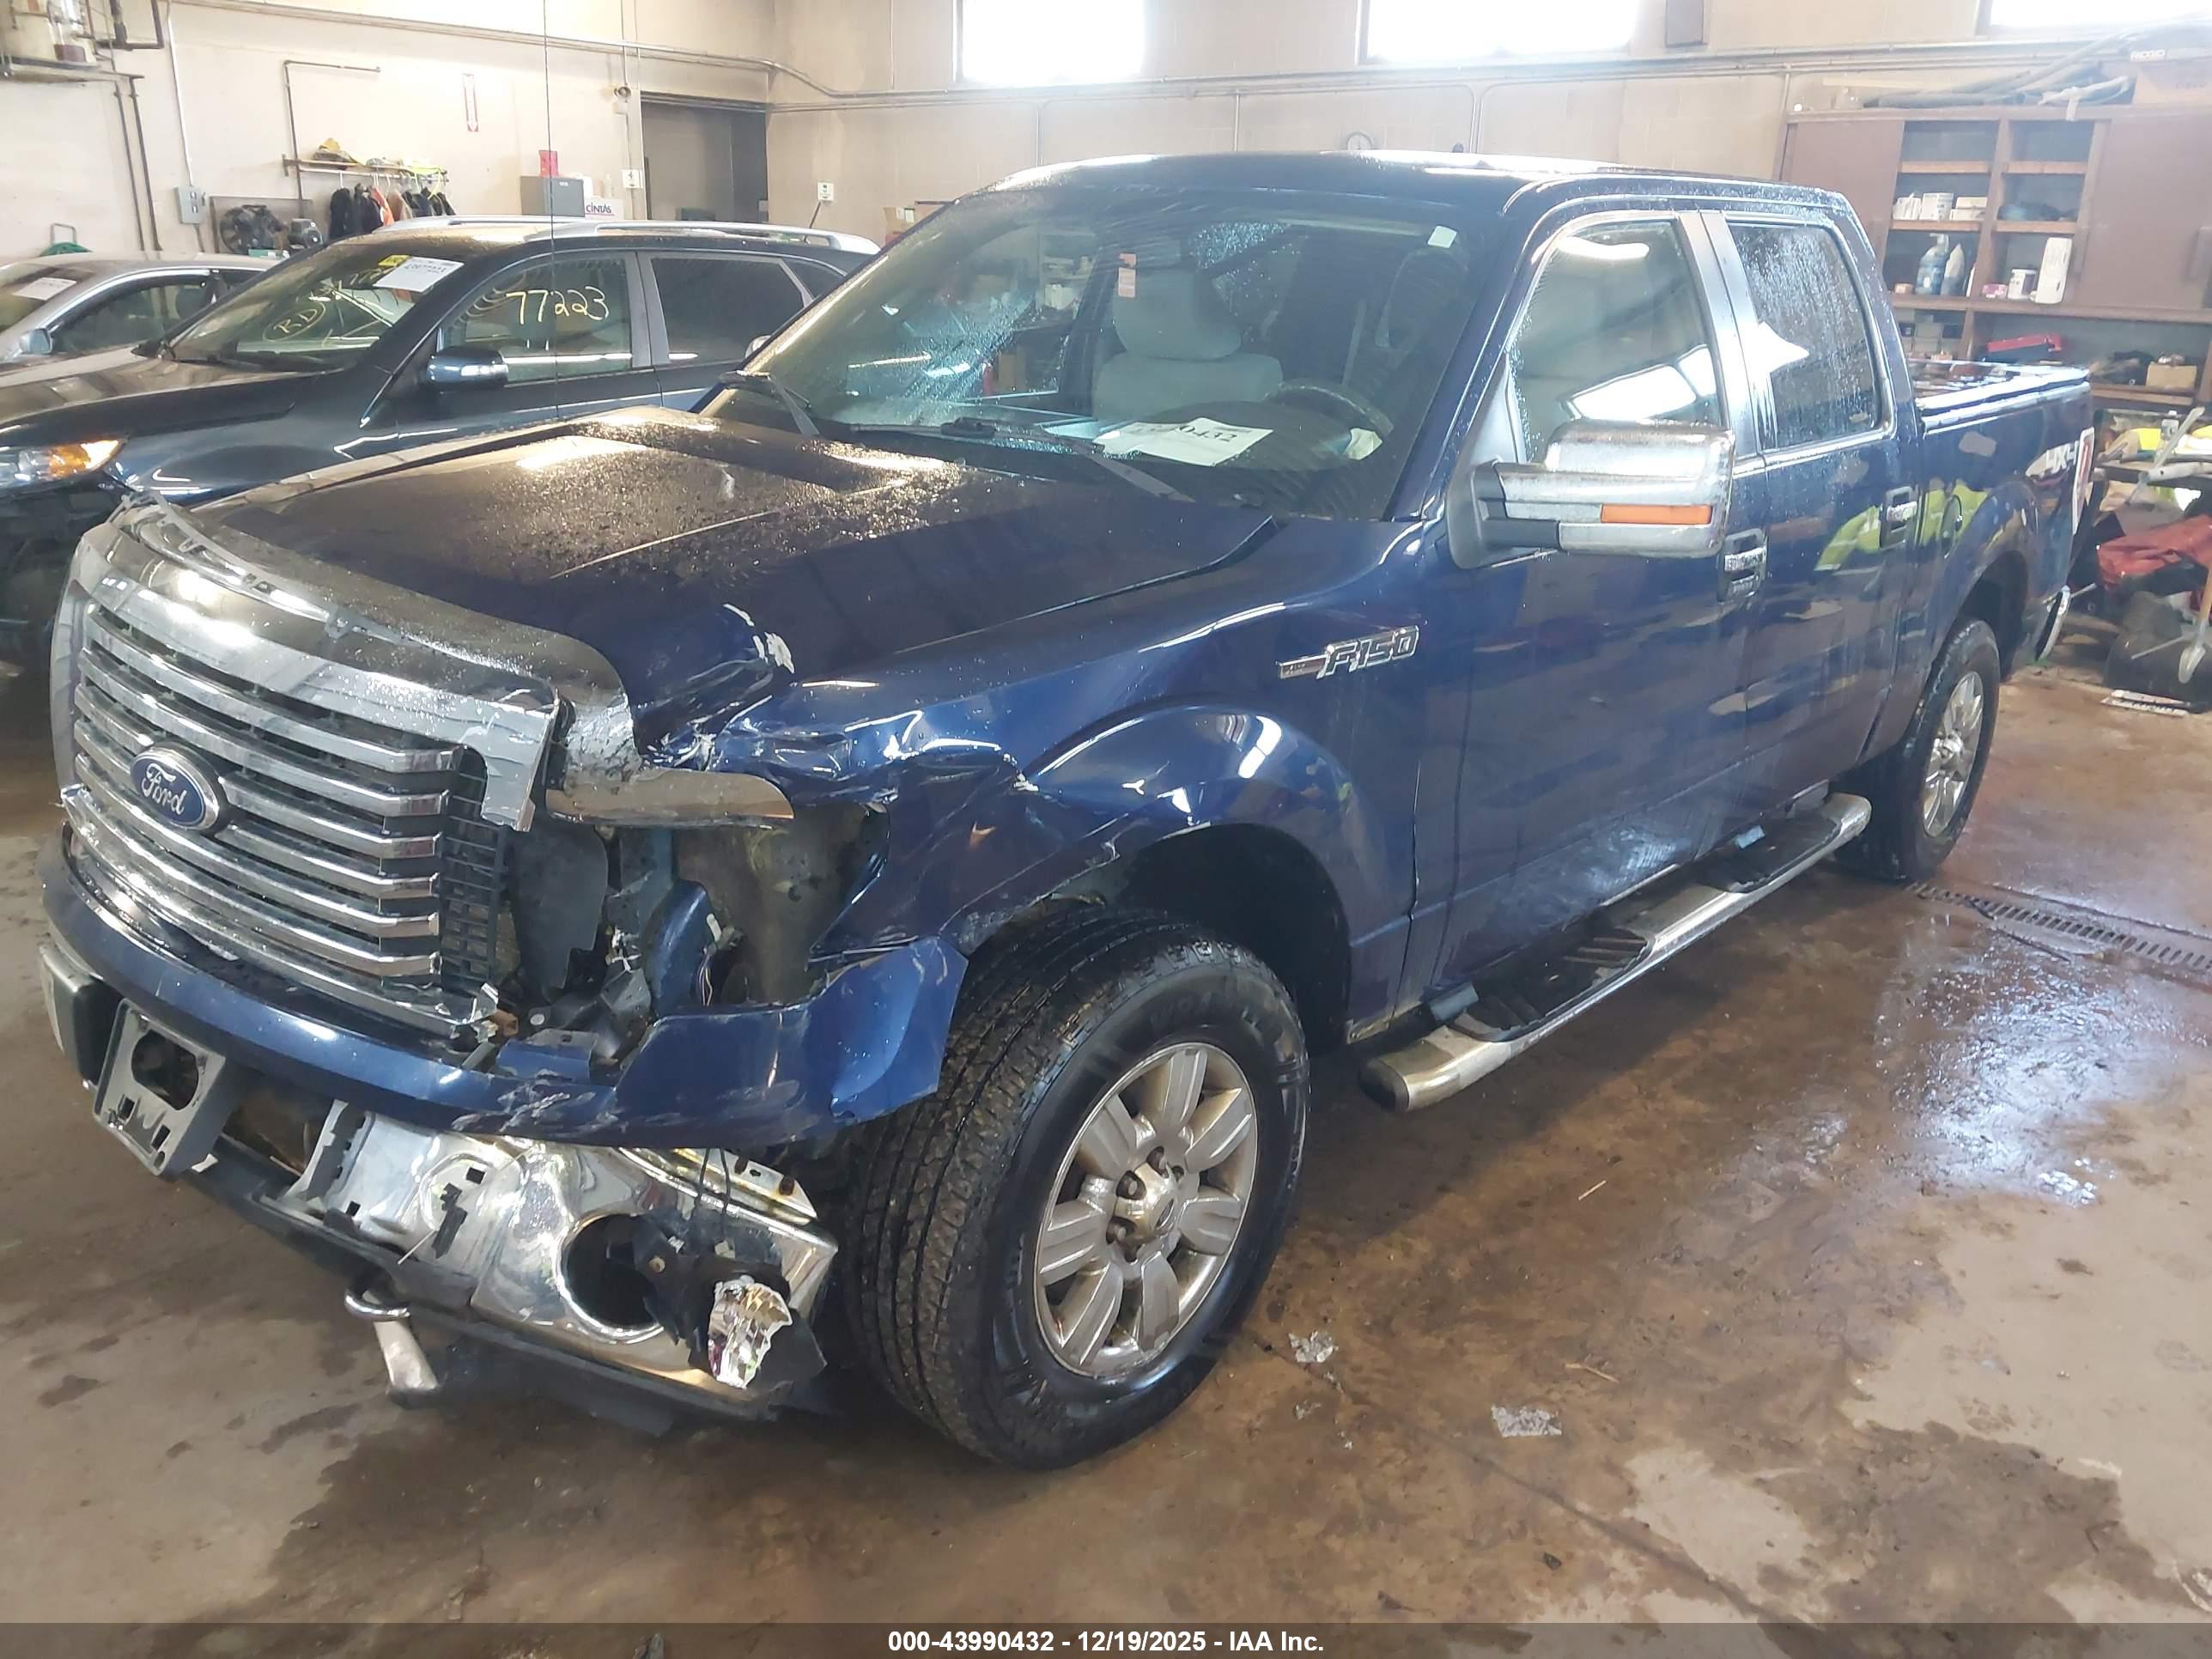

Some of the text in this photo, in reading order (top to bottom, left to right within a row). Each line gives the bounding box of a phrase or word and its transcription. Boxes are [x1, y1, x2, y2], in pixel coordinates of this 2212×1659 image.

[586, 202, 612, 214] CINTAS
[506, 285, 610, 325] 77223
[141, 763, 185, 816] Ford
